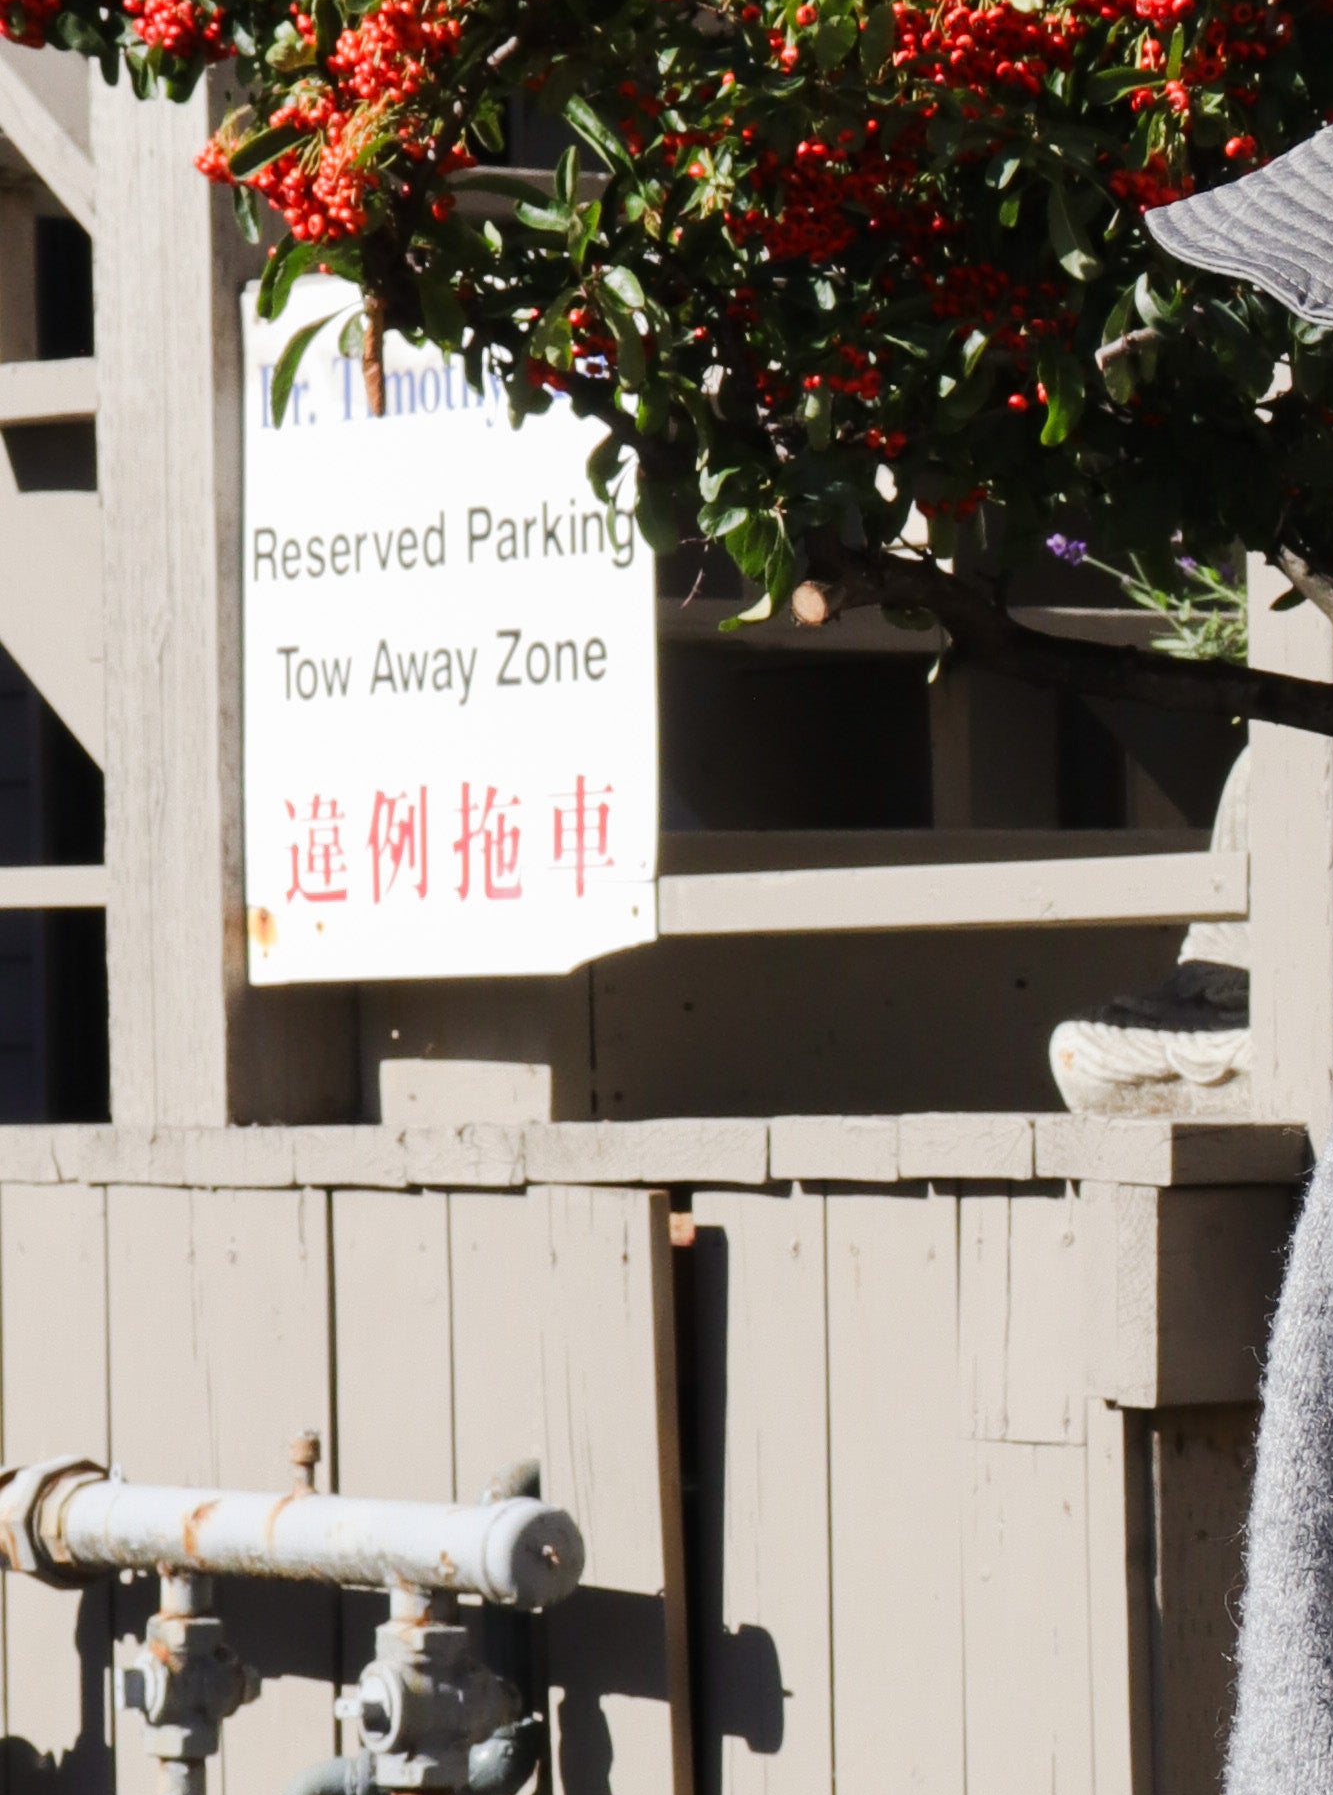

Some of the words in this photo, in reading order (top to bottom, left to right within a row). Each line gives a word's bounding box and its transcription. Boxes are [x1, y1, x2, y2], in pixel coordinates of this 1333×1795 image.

[254, 511, 445, 581] Reserved
[468, 499, 635, 568] Parking
[277, 646, 351, 700] Tow
[370, 639, 477, 706] Away
[496, 629, 607, 686] Zone
[285, 775, 614, 904] 違例拖車
